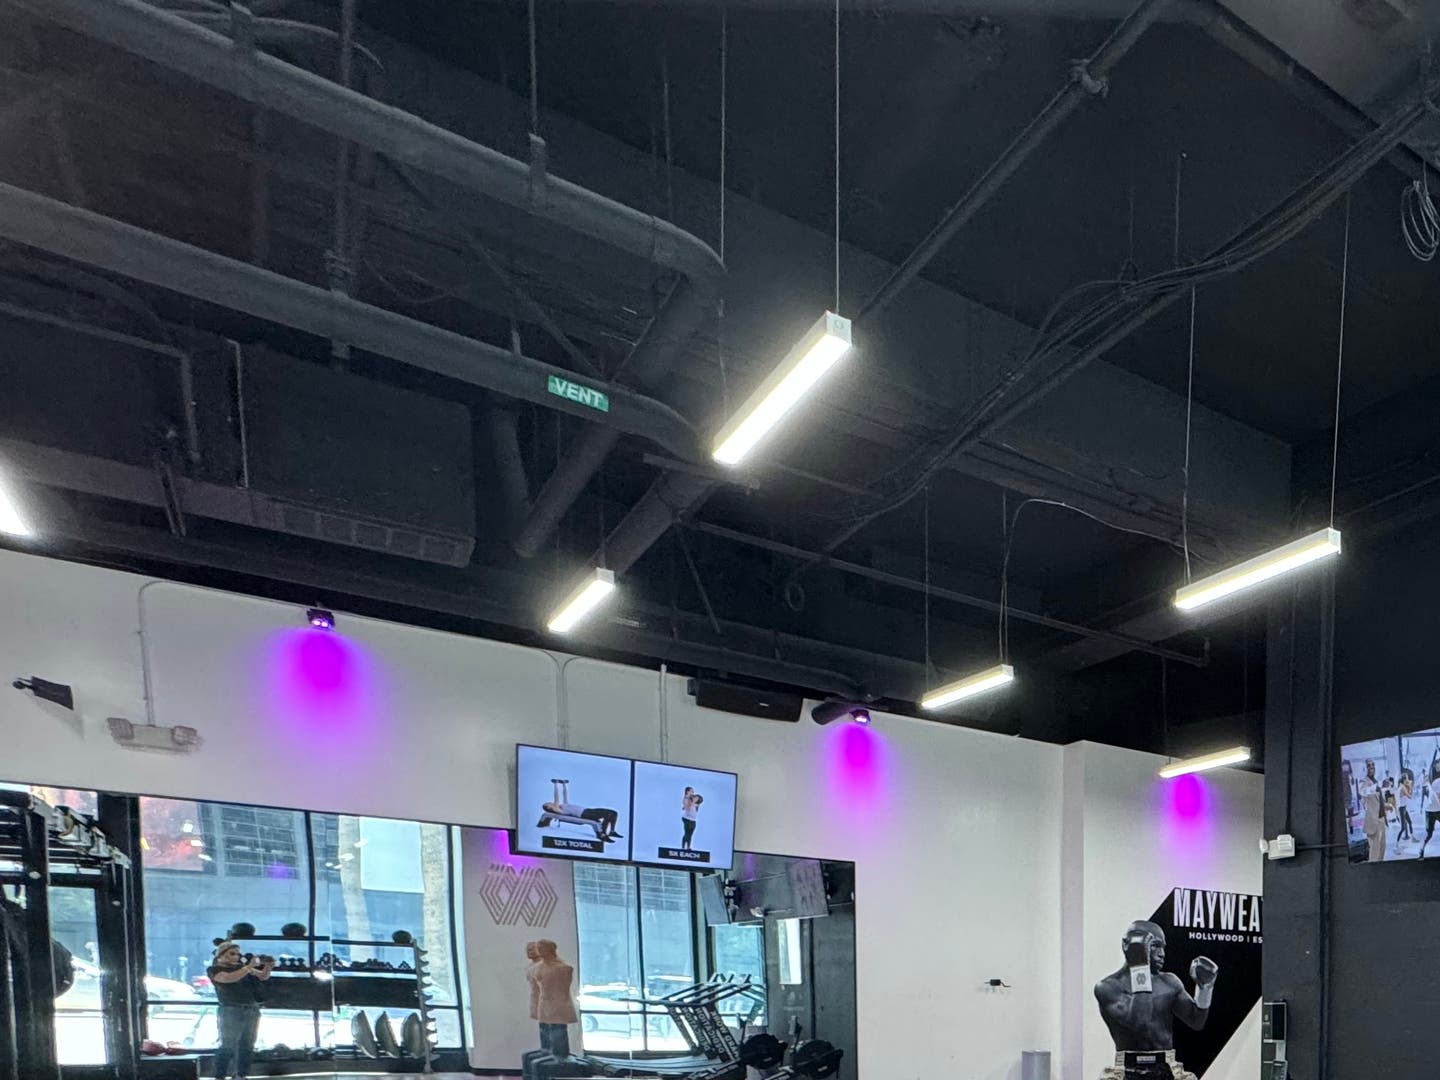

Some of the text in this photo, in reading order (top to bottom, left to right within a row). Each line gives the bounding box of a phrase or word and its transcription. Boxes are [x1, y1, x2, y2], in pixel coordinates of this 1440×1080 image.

[554, 377, 603, 408] VENT
[568, 841, 593, 849] TOTAL
[680, 851, 701, 859] EACH
[1173, 887, 1263, 933] MAYWEA
[1188, 931, 1244, 943] HOLLYWOOD
